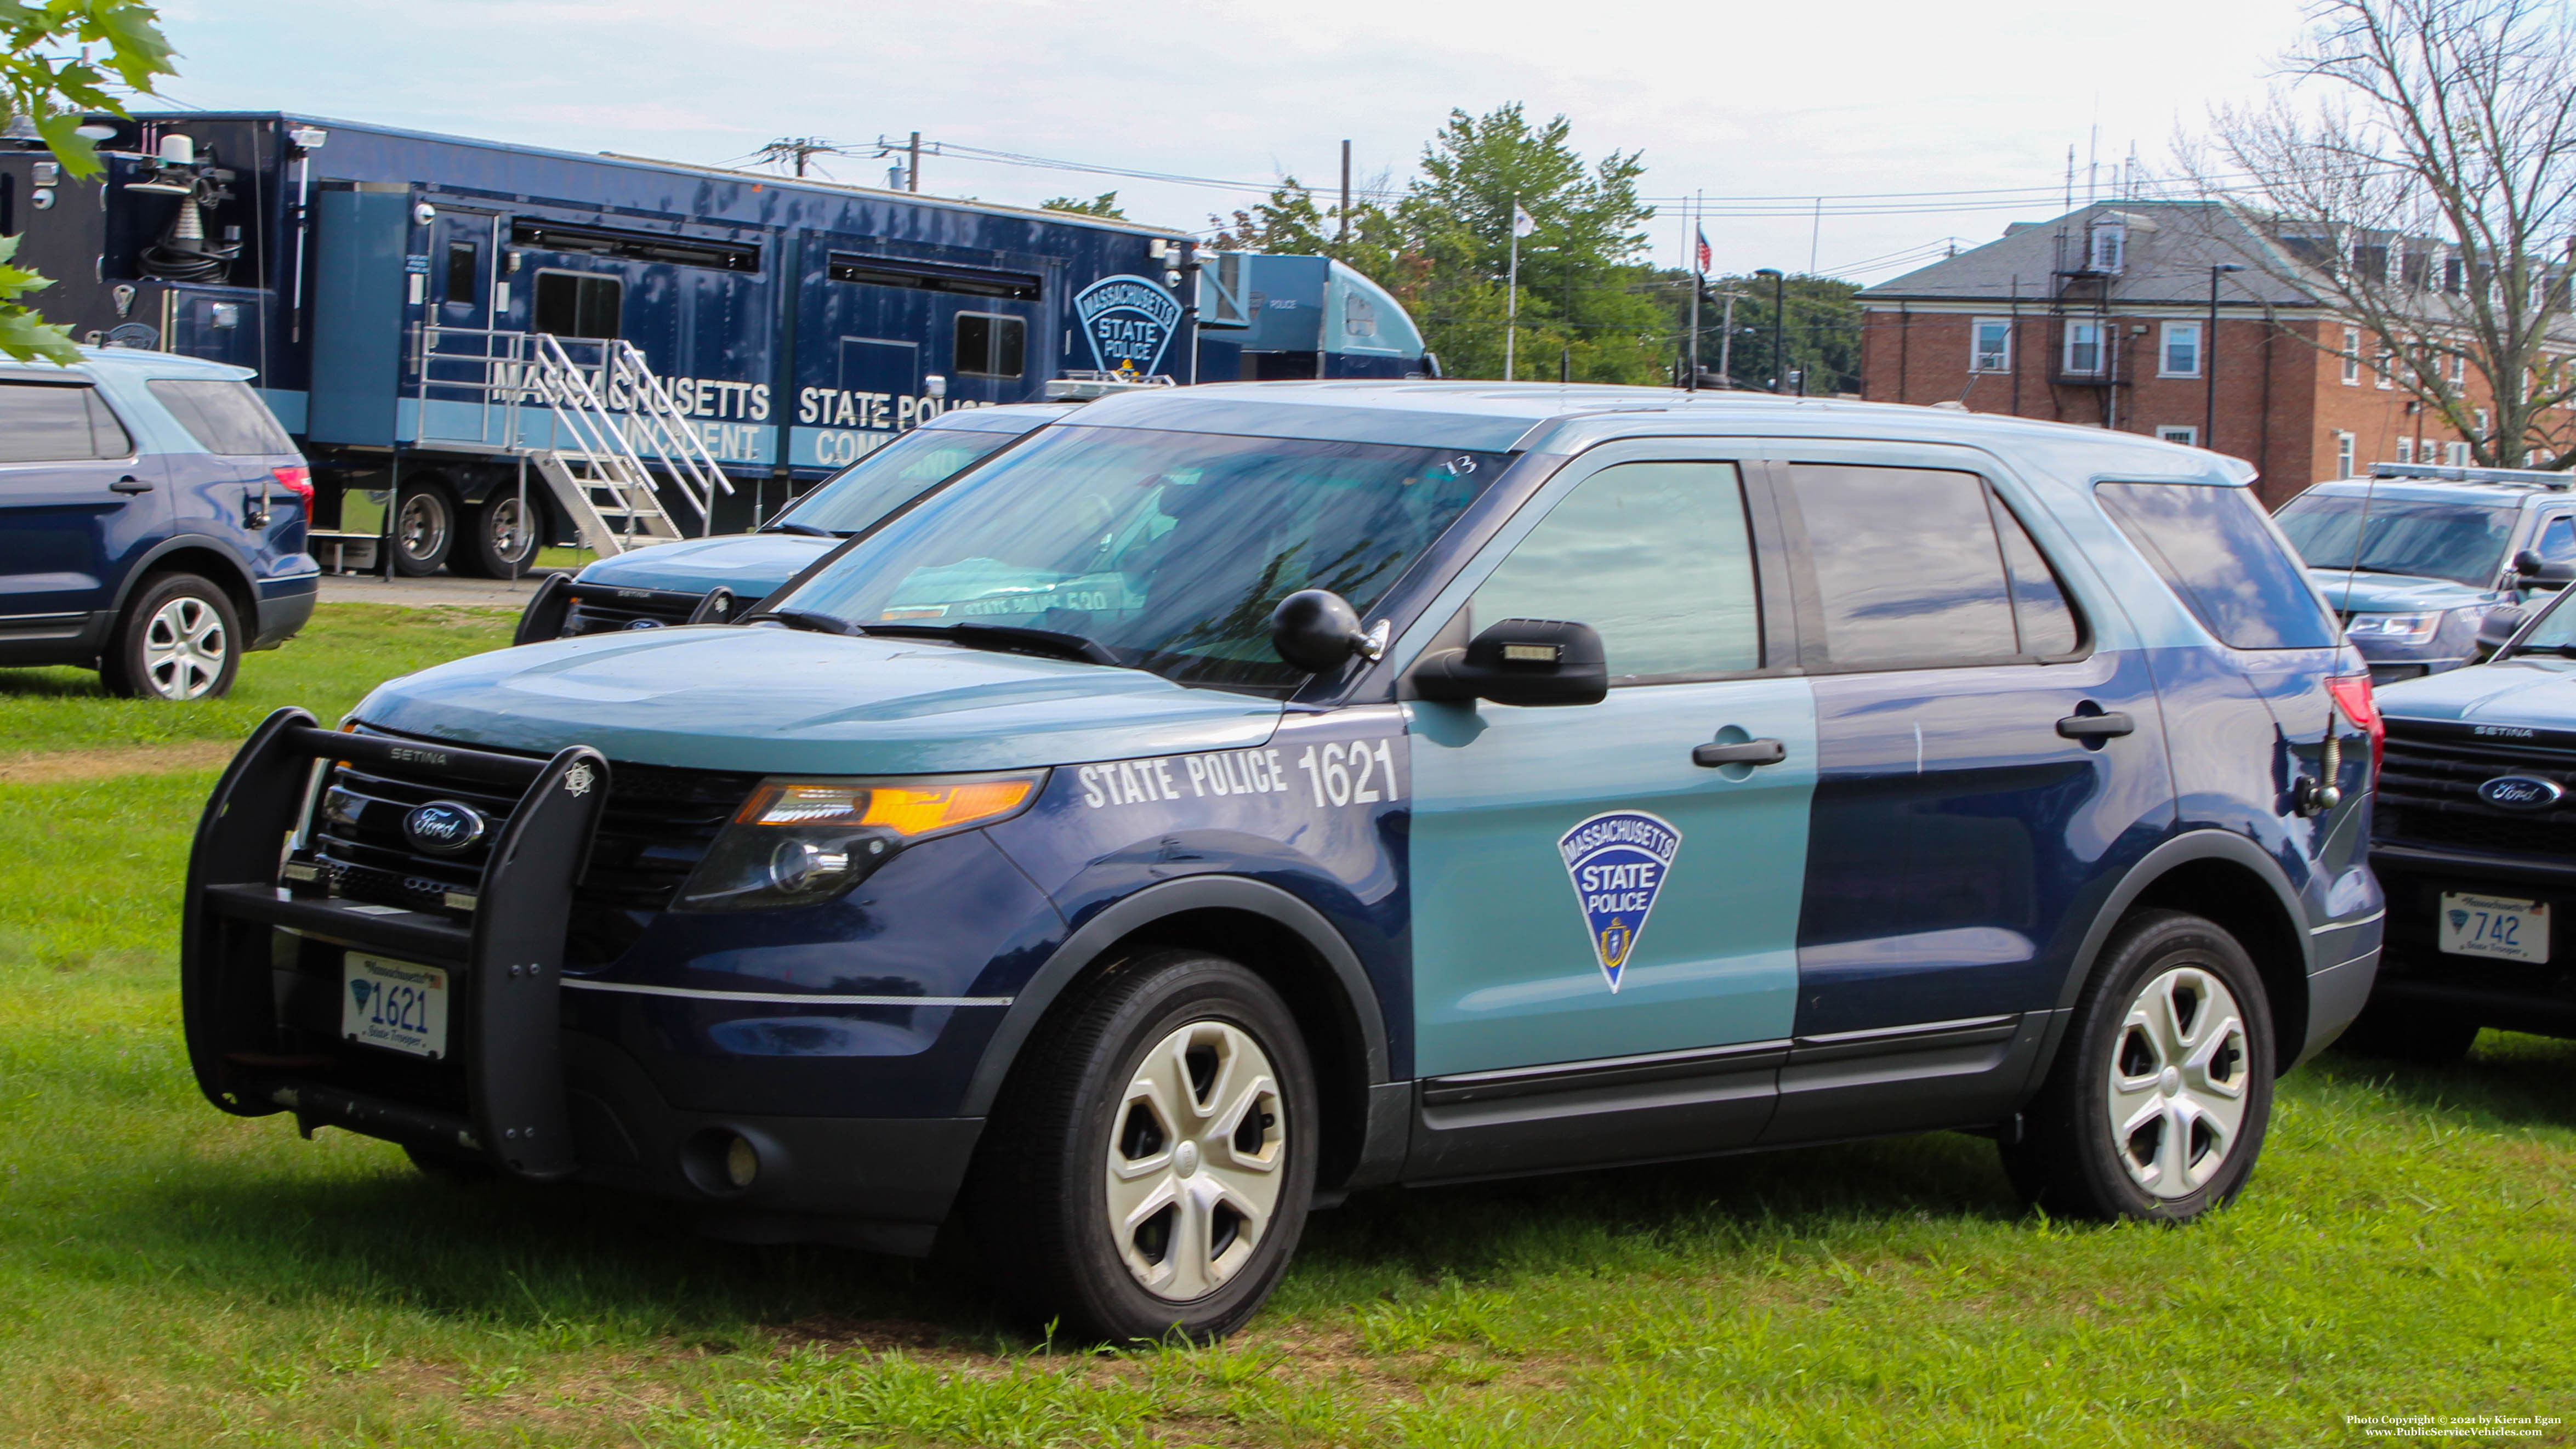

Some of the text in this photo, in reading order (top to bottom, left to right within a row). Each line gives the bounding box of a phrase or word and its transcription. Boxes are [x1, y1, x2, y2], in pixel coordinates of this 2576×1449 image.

[1083, 283, 1175, 325] MASSACHUSETTS
[1269, 299, 1297, 309] POLICE
[1097, 317, 1158, 343] STATE
[1104, 340, 1152, 361] POLICE
[798, 386, 891, 429] STATE
[1438, 454, 1477, 476] 13
[2474, 725, 2534, 738] SETINA
[391, 747, 447, 766] SETINA
[1078, 738, 1399, 809] STATE POLICE 1621
[2492, 782, 2540, 801] Ford
[414, 808, 461, 840] Ford
[1564, 819, 1675, 863] MASSACHUSETTS
[1581, 862, 1657, 893] STATE
[1588, 891, 1648, 914] POLICE
[2475, 912, 2520, 946] 742
[371, 981, 429, 1034] 1621
